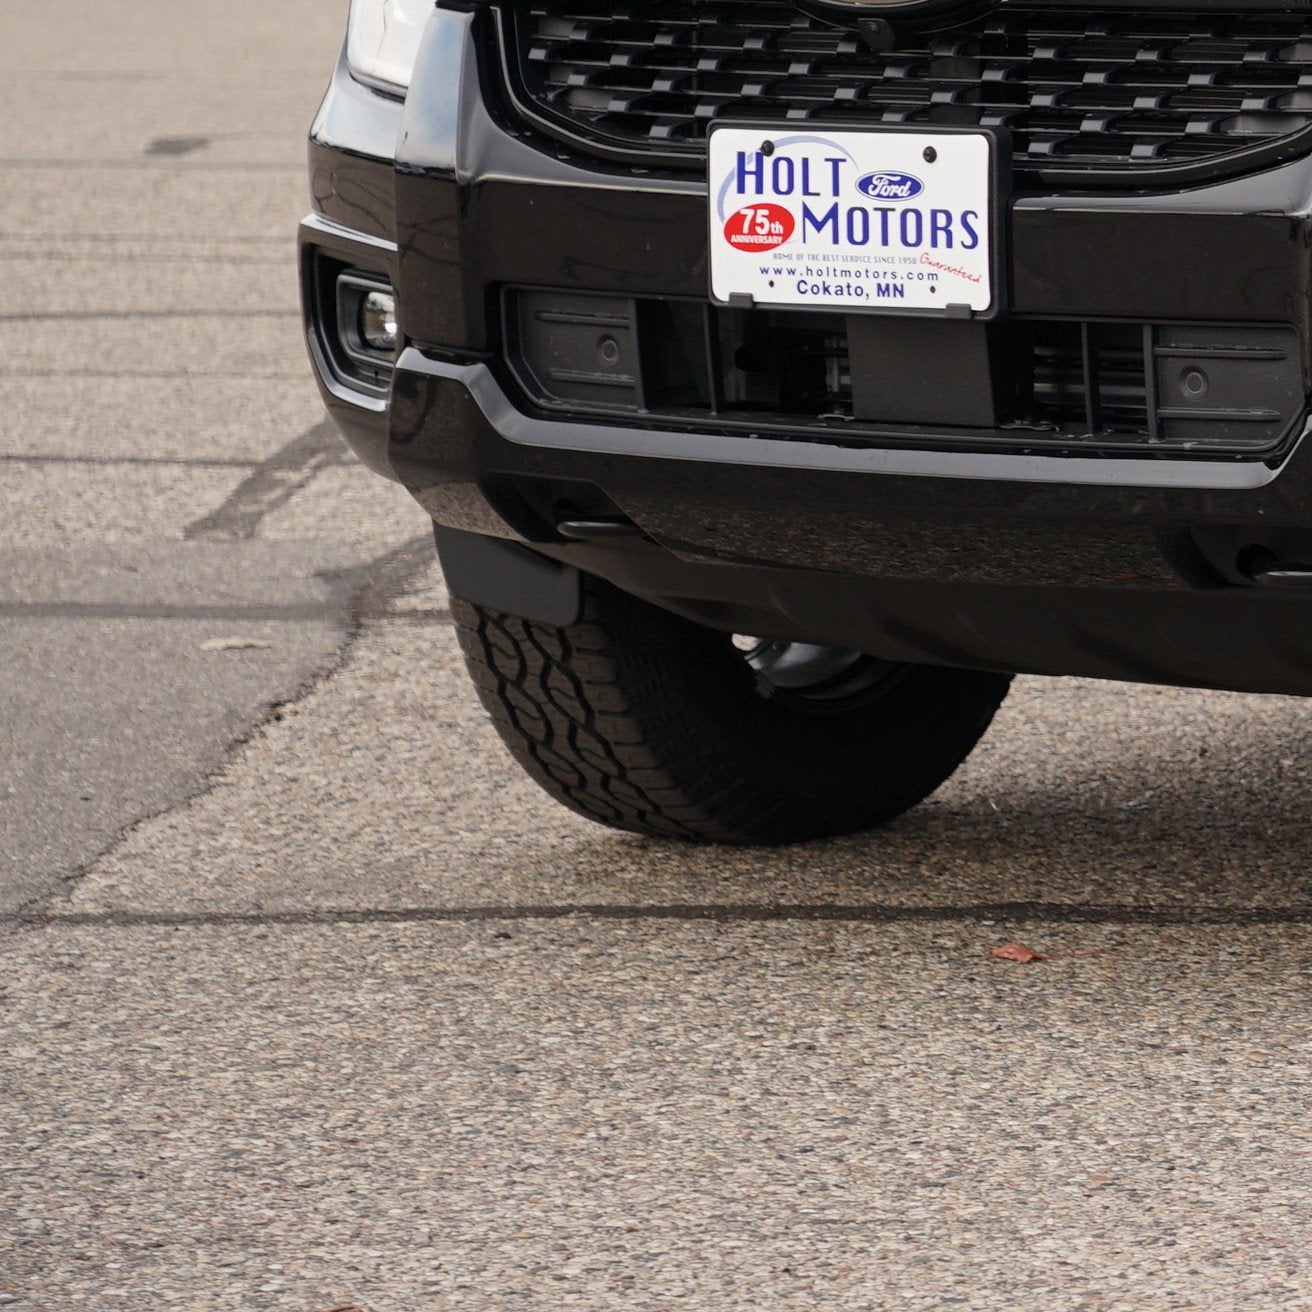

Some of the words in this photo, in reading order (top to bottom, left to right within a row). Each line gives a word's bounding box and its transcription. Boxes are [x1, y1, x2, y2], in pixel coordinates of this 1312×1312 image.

[736, 151, 847, 198] HOLT
[867, 174, 912, 198] Ford
[740, 208, 784, 235] 75th
[802, 200, 980, 250] MOTORS
[730, 233, 783, 245] ANNIVERSARY
[772, 252, 794, 262] HOME
[795, 253, 805, 262] OF
[806, 253, 820, 263] THE
[822, 253, 840, 264] BEST
[841, 254, 872, 265] SERVICE
[874, 255, 896, 266] SINCE
[897, 256, 918, 266] 1950
[919, 251, 983, 284] Guaranteed
[759, 264, 939, 282] www.holtmotors.com
[796, 280, 870, 300] Cokato,
[876, 283, 906, 299] MN
